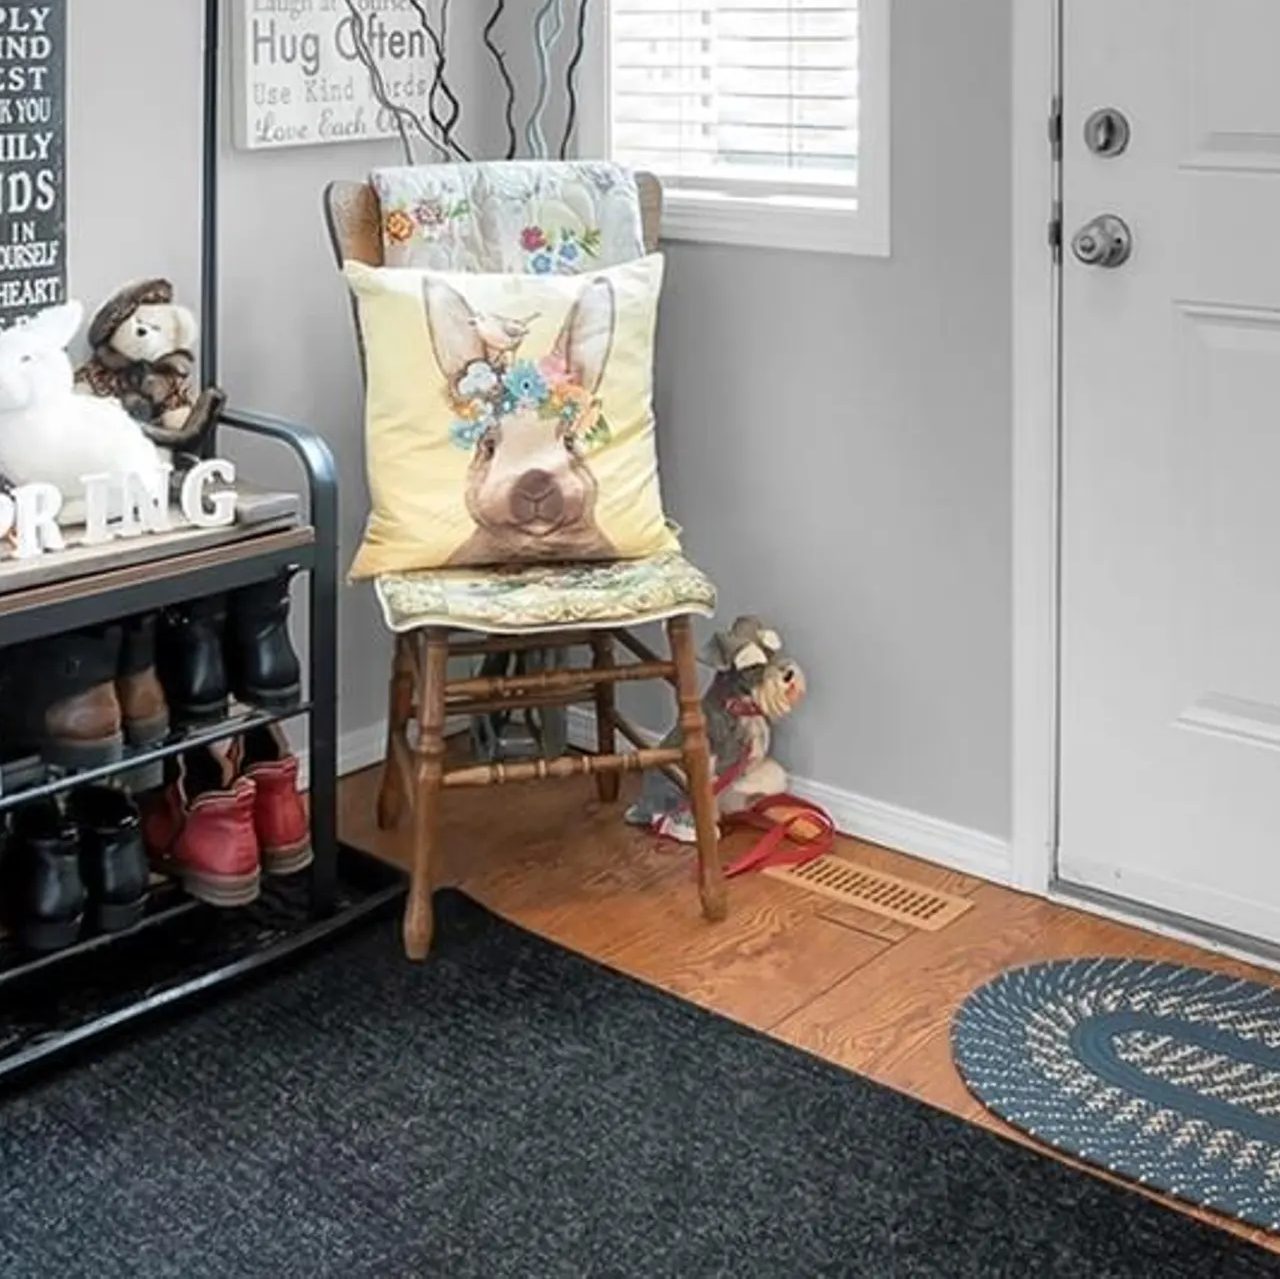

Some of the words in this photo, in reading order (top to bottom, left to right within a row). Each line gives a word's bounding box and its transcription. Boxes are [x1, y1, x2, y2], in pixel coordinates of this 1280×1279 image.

[253, 18, 320, 76] Hug
[335, 11, 426, 61] Often
[304, 75, 354, 103] Kind
[15, 96, 52, 123] YOU
[318, 107, 366, 138] Each
[11, 221, 36, 243] IN
